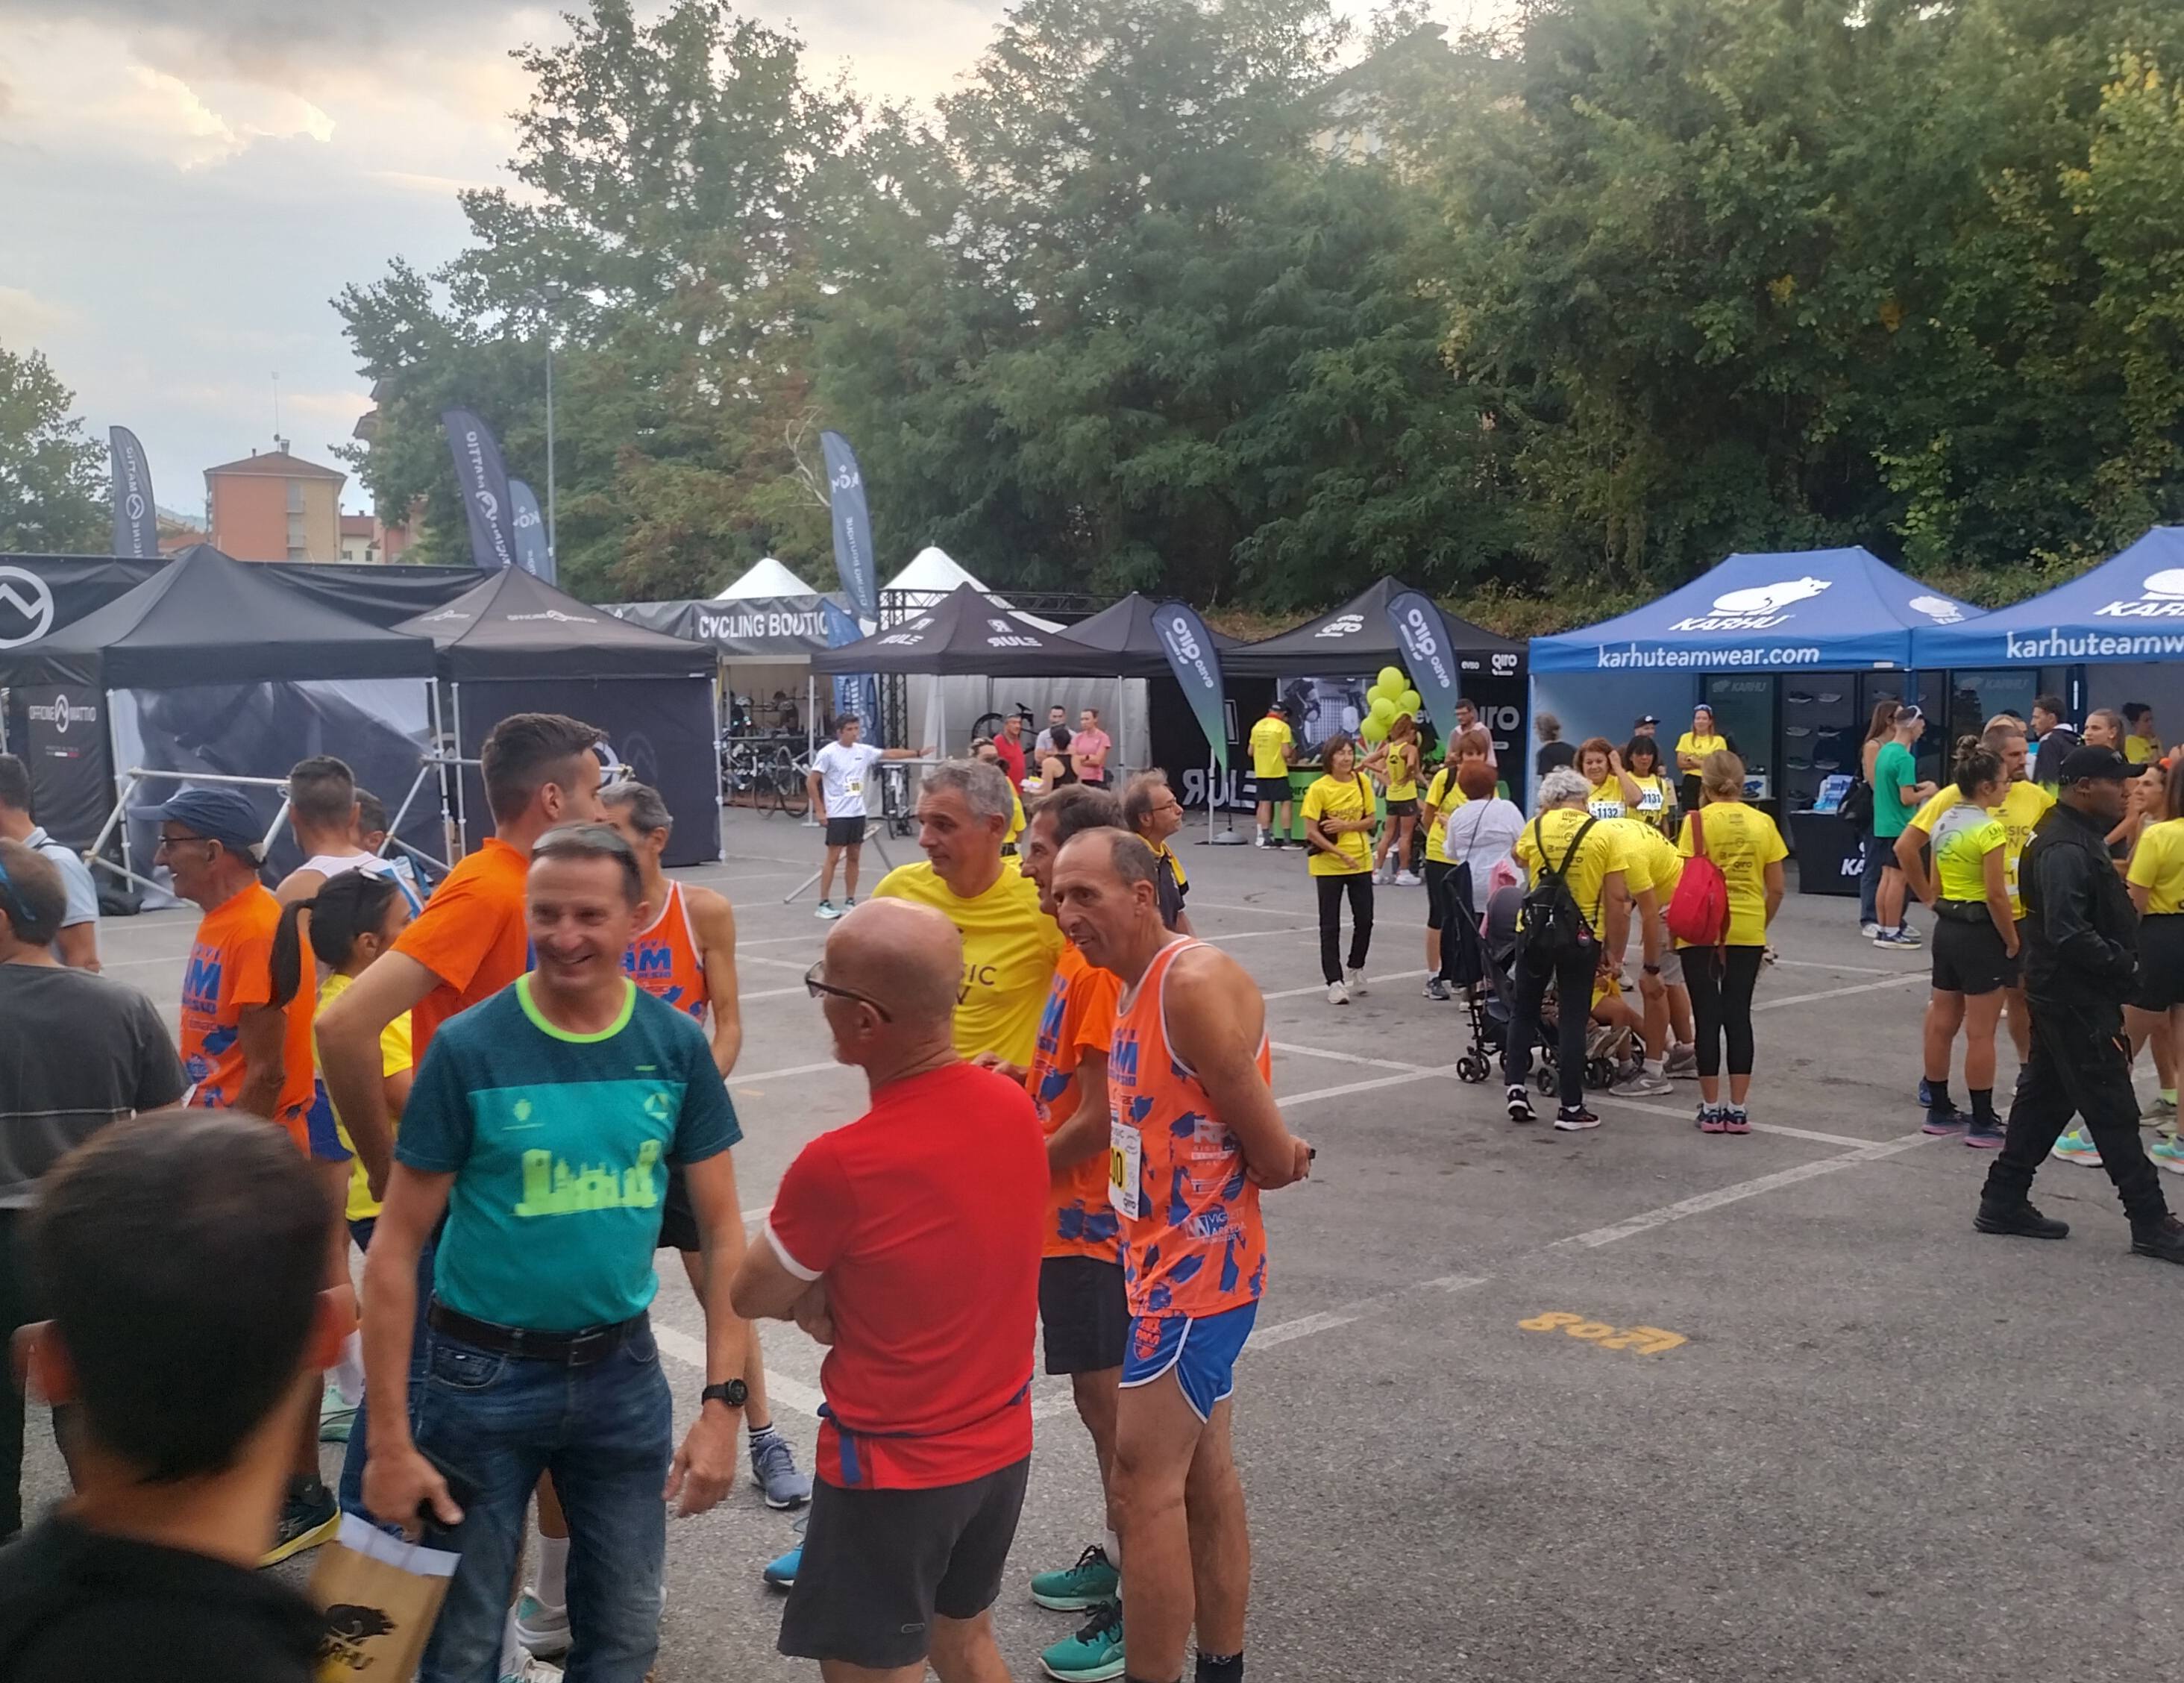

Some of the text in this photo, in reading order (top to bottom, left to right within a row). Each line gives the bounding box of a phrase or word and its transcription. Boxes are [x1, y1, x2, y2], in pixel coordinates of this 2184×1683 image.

[2092, 601, 2184, 617] KAR
[699, 612, 828, 638] CYCLING BOUTIQ
[1668, 615, 1790, 630] KARHU
[1597, 642, 1820, 668] karhuteamwear.com
[1730, 680, 1767, 692] KARHU
[1597, 807, 1618, 818] 1132
[2005, 825, 2030, 836] SIC
[618, 947, 671, 972] AM
